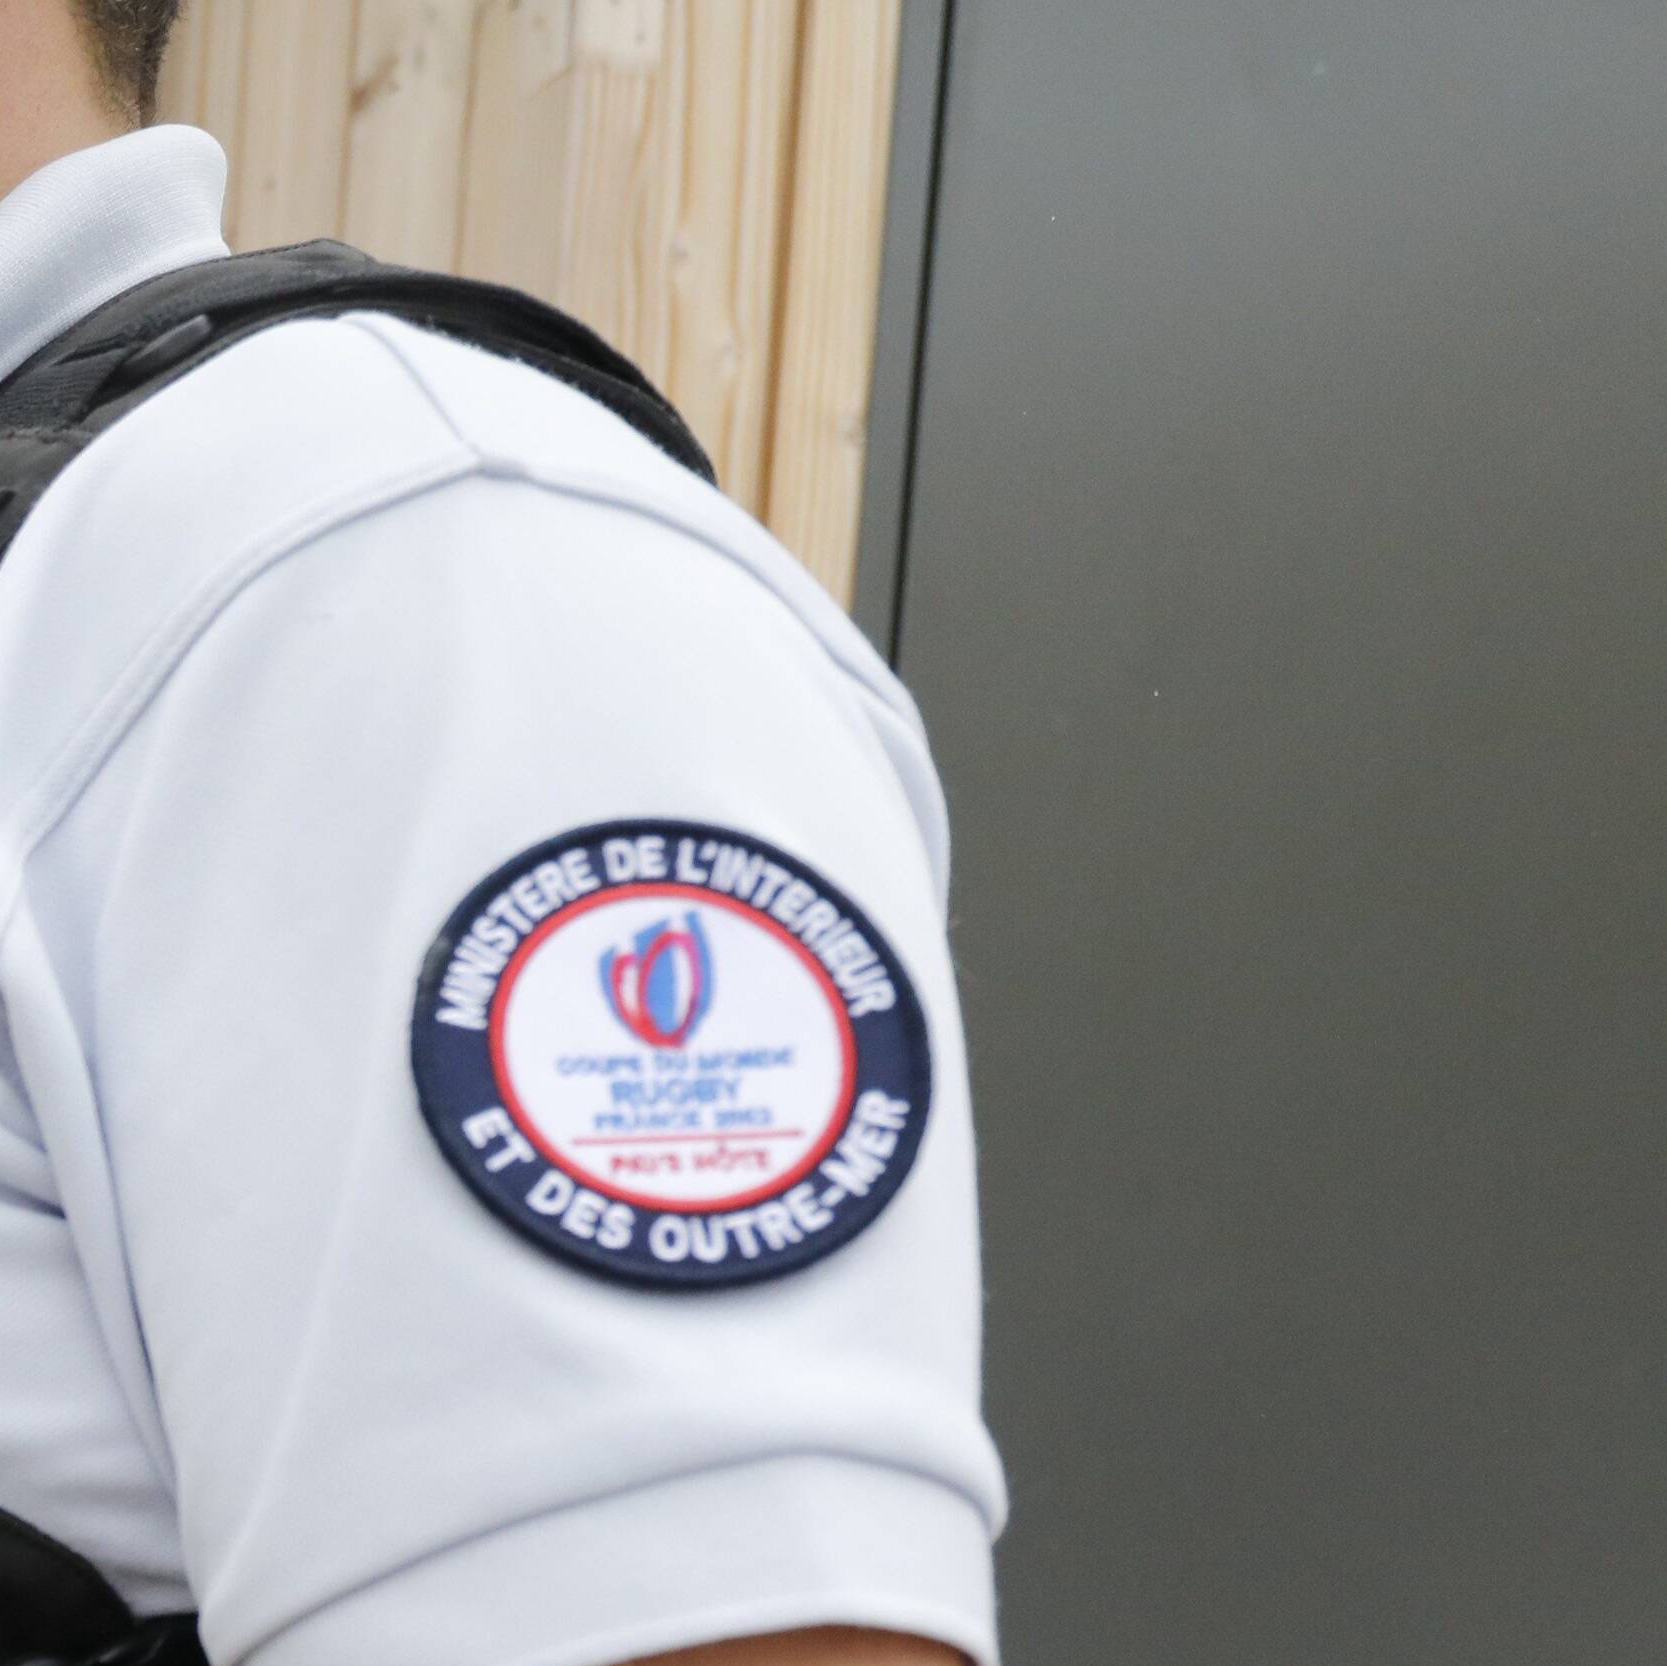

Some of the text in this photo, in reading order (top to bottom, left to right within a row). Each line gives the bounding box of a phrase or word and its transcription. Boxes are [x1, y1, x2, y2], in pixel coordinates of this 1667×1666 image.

[435, 835, 897, 1030] MINISTERE DE L'INTERIEUR
[594, 1109, 700, 1131] FRANCE
[610, 1077, 741, 1105] RUGBY
[462, 1090, 910, 1263] ET DES OUTRE-MER
